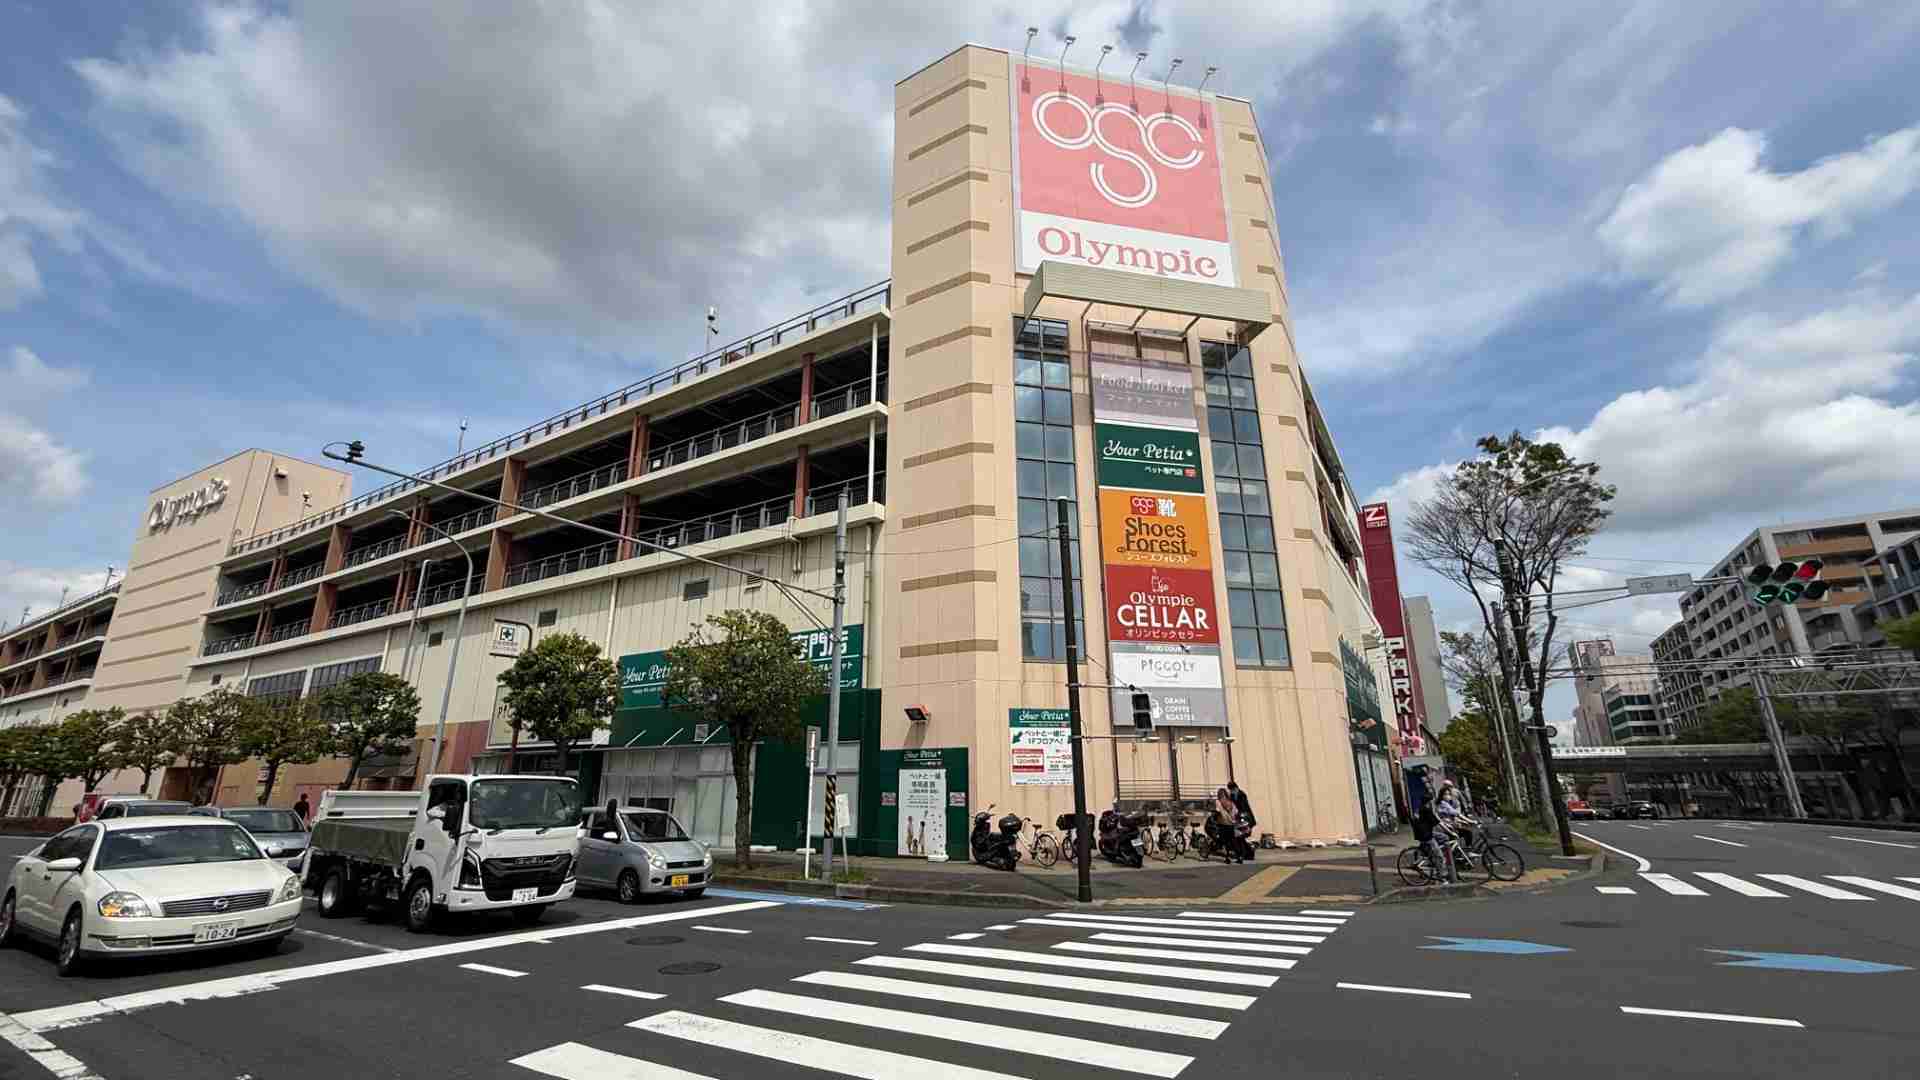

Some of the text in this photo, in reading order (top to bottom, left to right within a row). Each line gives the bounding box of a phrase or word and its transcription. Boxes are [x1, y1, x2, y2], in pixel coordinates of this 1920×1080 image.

[1037, 227, 1218, 277] Olympic
[1137, 378, 1185, 394] Market
[1103, 440, 1184, 460] Your Petia
[1125, 517, 1186, 538] Shoes
[1125, 530, 1188, 555] Forest
[1130, 591, 1195, 607] Olympic
[1117, 604, 1209, 629] CELLAR
[1126, 628, 1204, 640] オリンピックセラー
[622, 666, 646, 685] Your
[204, 928, 238, 941] 10-24
